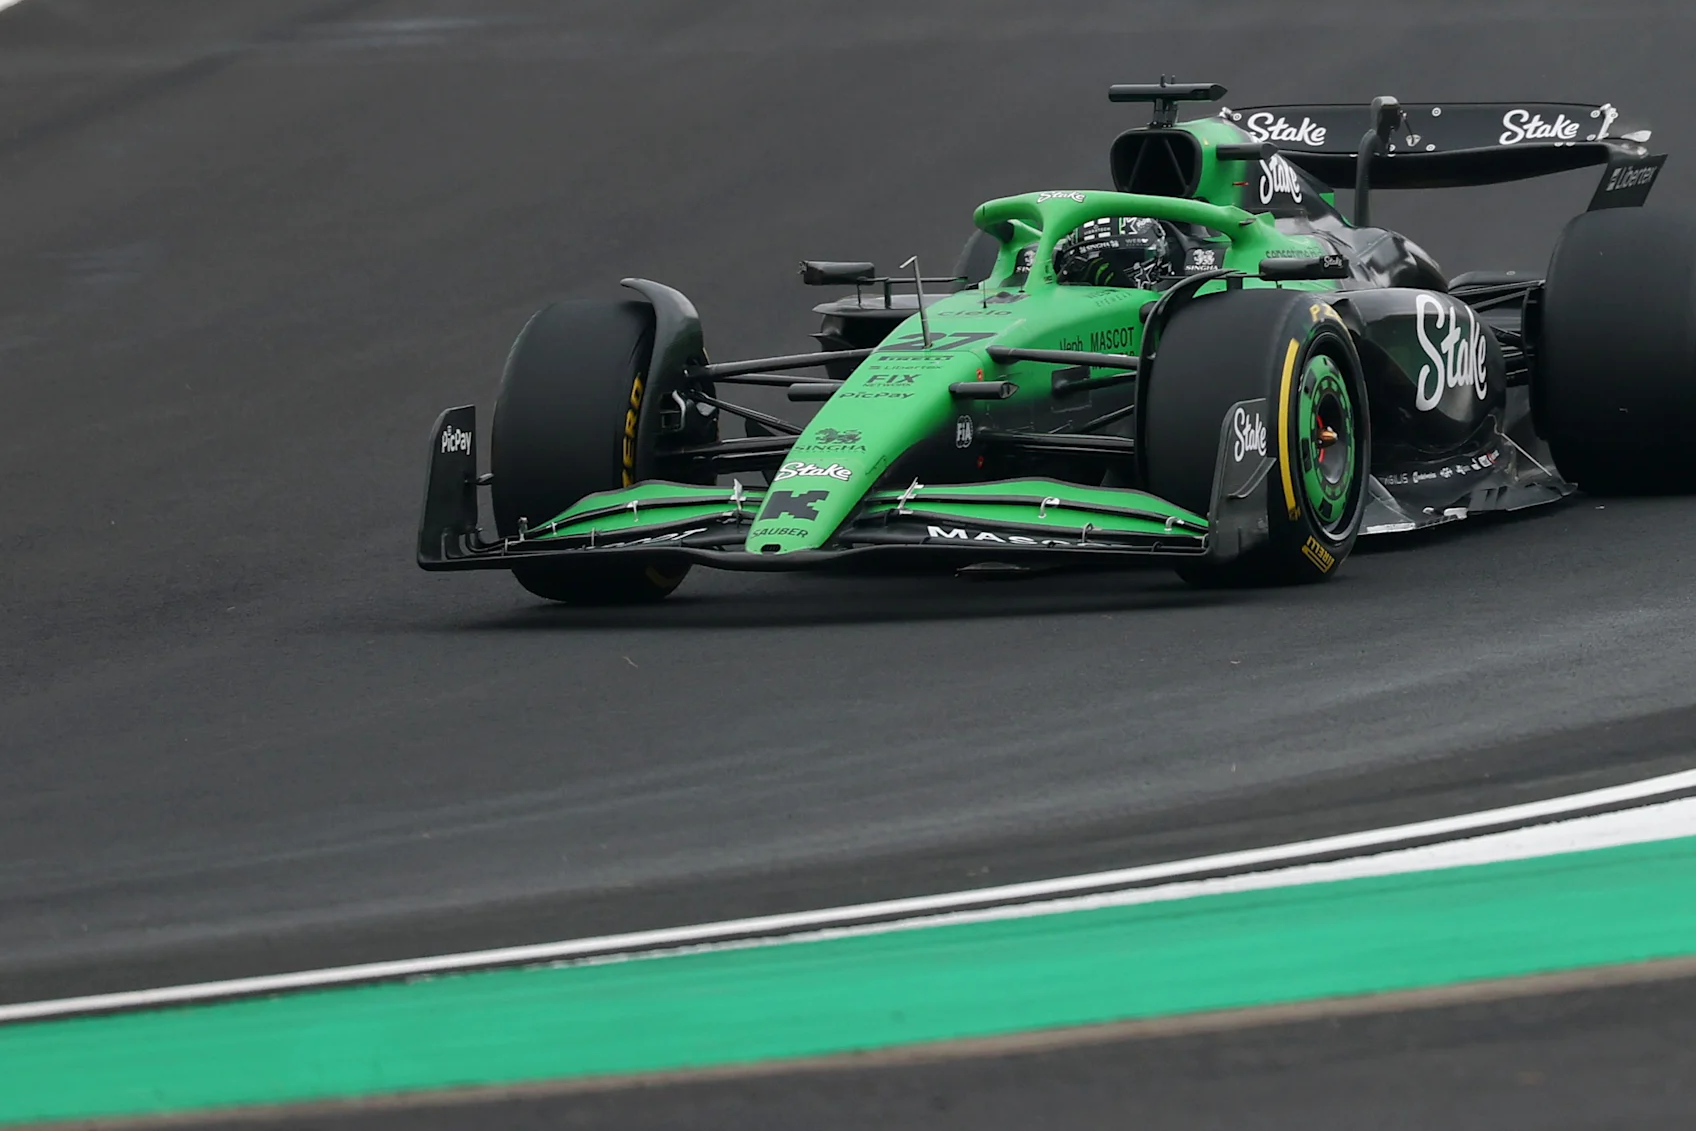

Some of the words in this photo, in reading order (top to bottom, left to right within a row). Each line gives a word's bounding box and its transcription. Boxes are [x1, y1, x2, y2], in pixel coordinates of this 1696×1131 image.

[1247, 112, 1327, 146] Stake
[1499, 109, 1580, 145] Stake
[1259, 153, 1302, 204] Stake
[1037, 191, 1086, 203] Stake
[879, 332, 999, 351] 27
[1090, 326, 1134, 352] MASCOT
[1415, 294, 1487, 411] Stake
[866, 374, 921, 384] FIX
[838, 391, 916, 400] PicPay
[441, 426, 472, 456] PicPay
[1233, 407, 1267, 462] Stake
[774, 461, 852, 482] Stake
[750, 527, 809, 539] SAUBER
